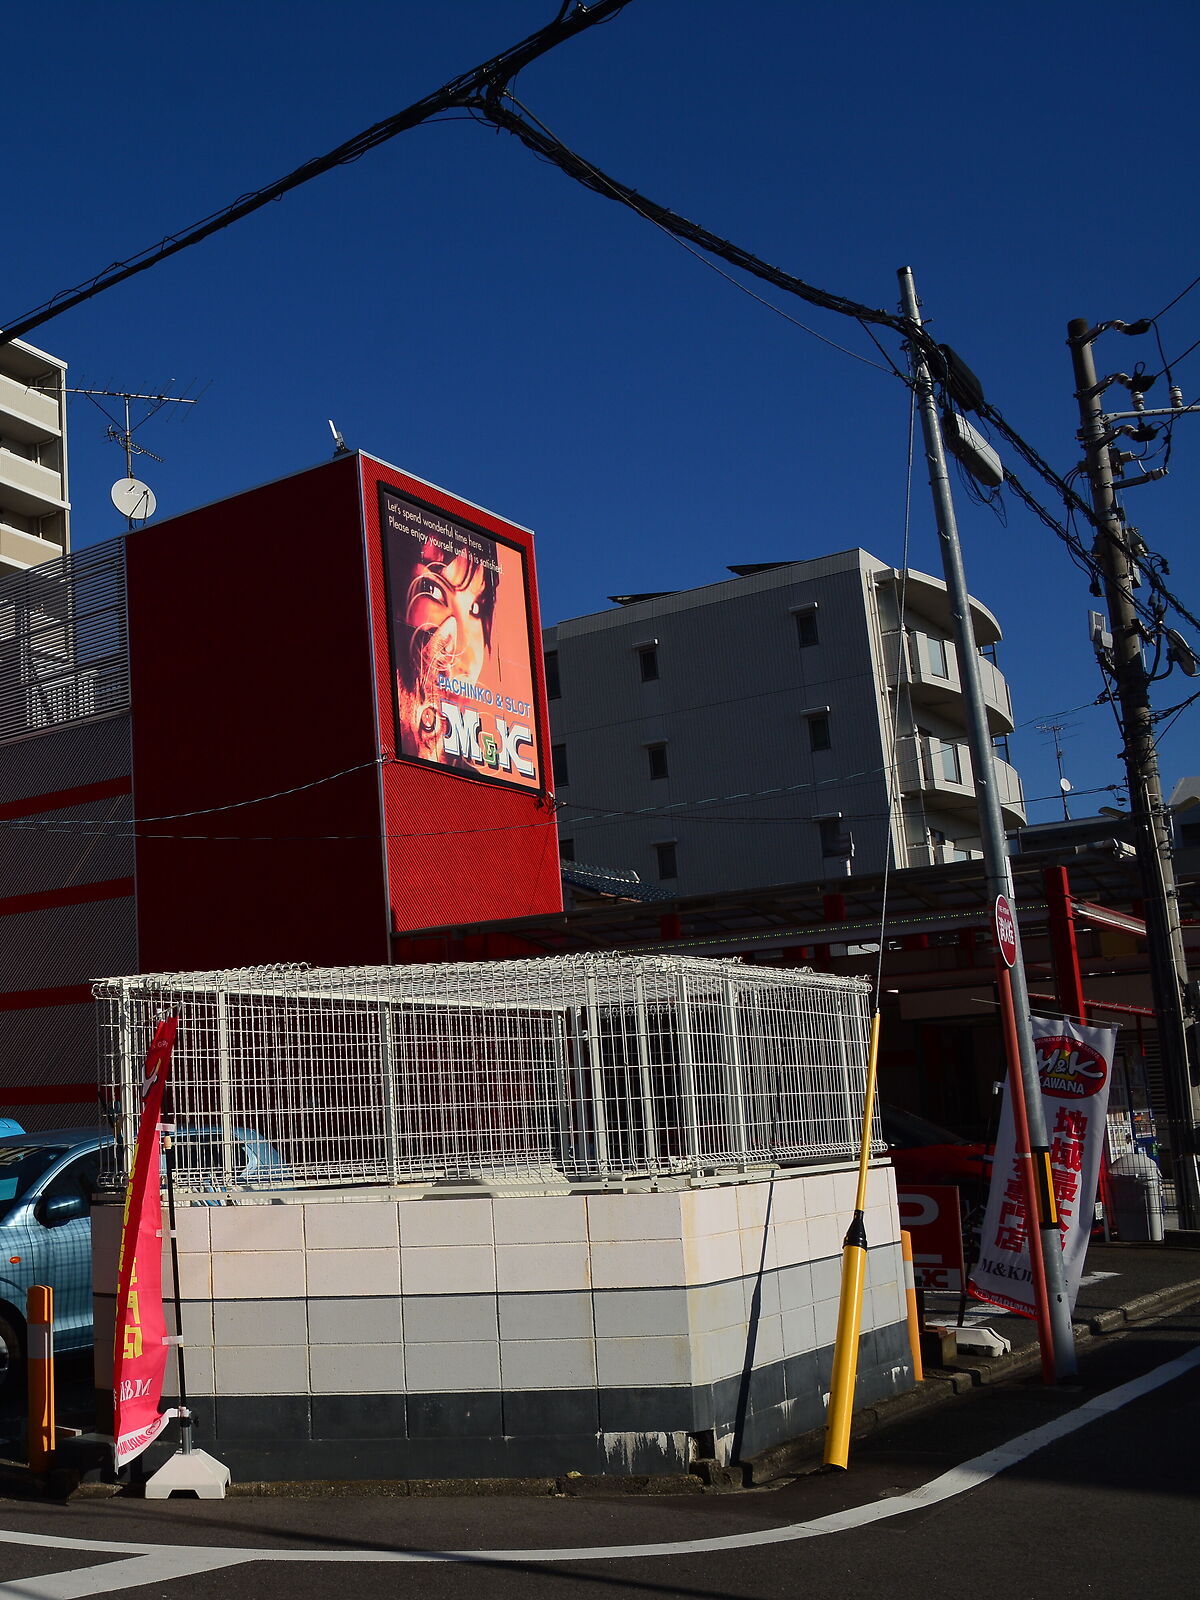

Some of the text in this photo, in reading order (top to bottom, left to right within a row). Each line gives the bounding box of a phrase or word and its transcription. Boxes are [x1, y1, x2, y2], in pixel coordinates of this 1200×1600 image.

[387, 499, 484, 552] Let's spend wonderful time here.
[388, 515, 409, 534] Please
[411, 528, 428, 546] enjoy
[428, 536, 454, 554] yourself
[454, 547, 468, 560] until
[480, 558, 505, 576] satisfied.
[438, 673, 530, 719] PACHINKO & SLOT
[1037, 1048, 1104, 1079] M&K
[1052, 1108, 1088, 1251] 地域最大
